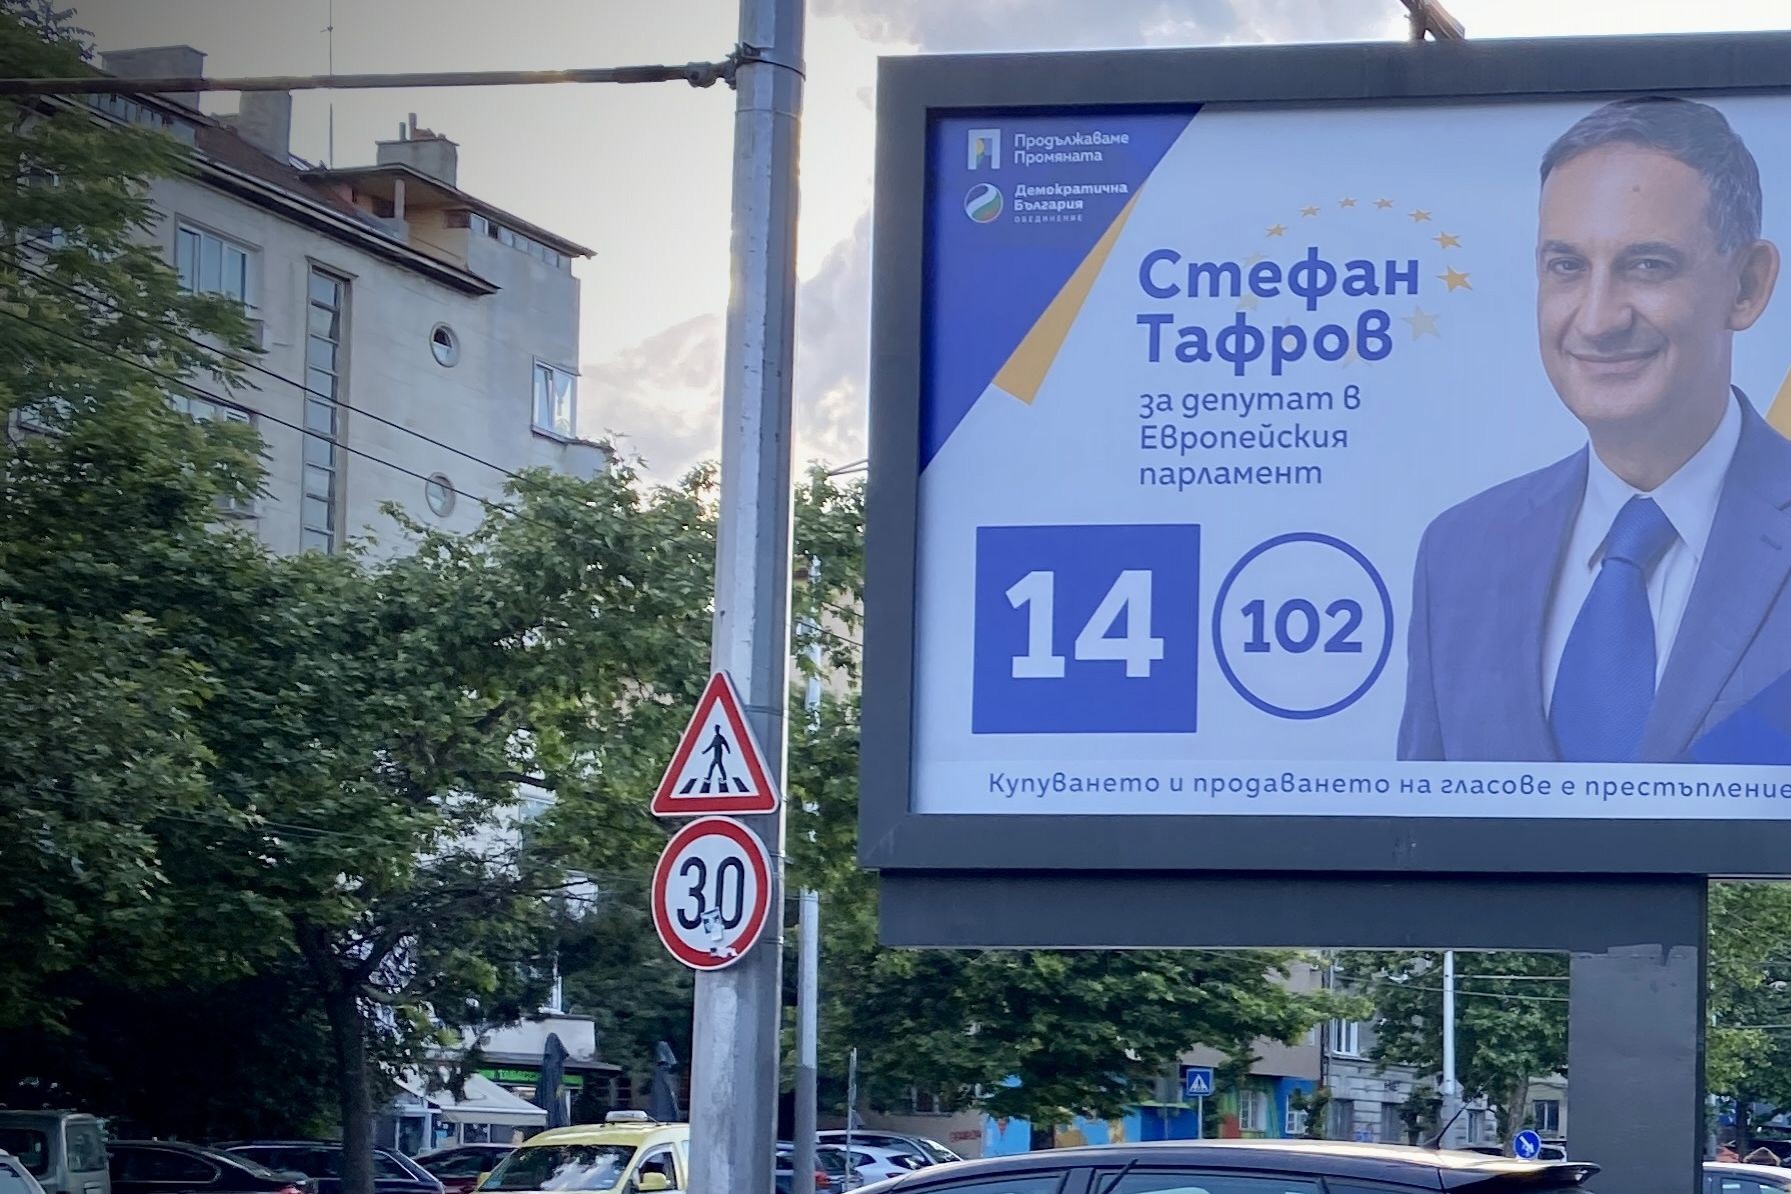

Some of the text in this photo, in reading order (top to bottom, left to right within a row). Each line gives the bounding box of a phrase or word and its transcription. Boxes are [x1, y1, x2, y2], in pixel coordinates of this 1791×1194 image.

[1014, 131, 1130, 150] Продължаваме
[1014, 150, 1103, 166] Промяната
[1013, 199, 1084, 212] България
[1014, 183, 1129, 197] Демократична
[1138, 246, 1419, 311] Стефан
[1136, 309, 1393, 376] Тафров
[1139, 385, 1361, 419] за депутат в
[1140, 423, 1348, 456] Европейския
[1139, 465, 1322, 492] парламент
[1005, 569, 1164, 678] 14
[1241, 598, 1363, 653] 102
[988, 772, 1160, 798] Купуването
[1169, 777, 1184, 793] и
[1194, 773, 1390, 798] продаването
[1400, 777, 1432, 794] на
[1440, 774, 1552, 795] гласове
[1560, 780, 1576, 796] е
[676, 856, 745, 930] 30
